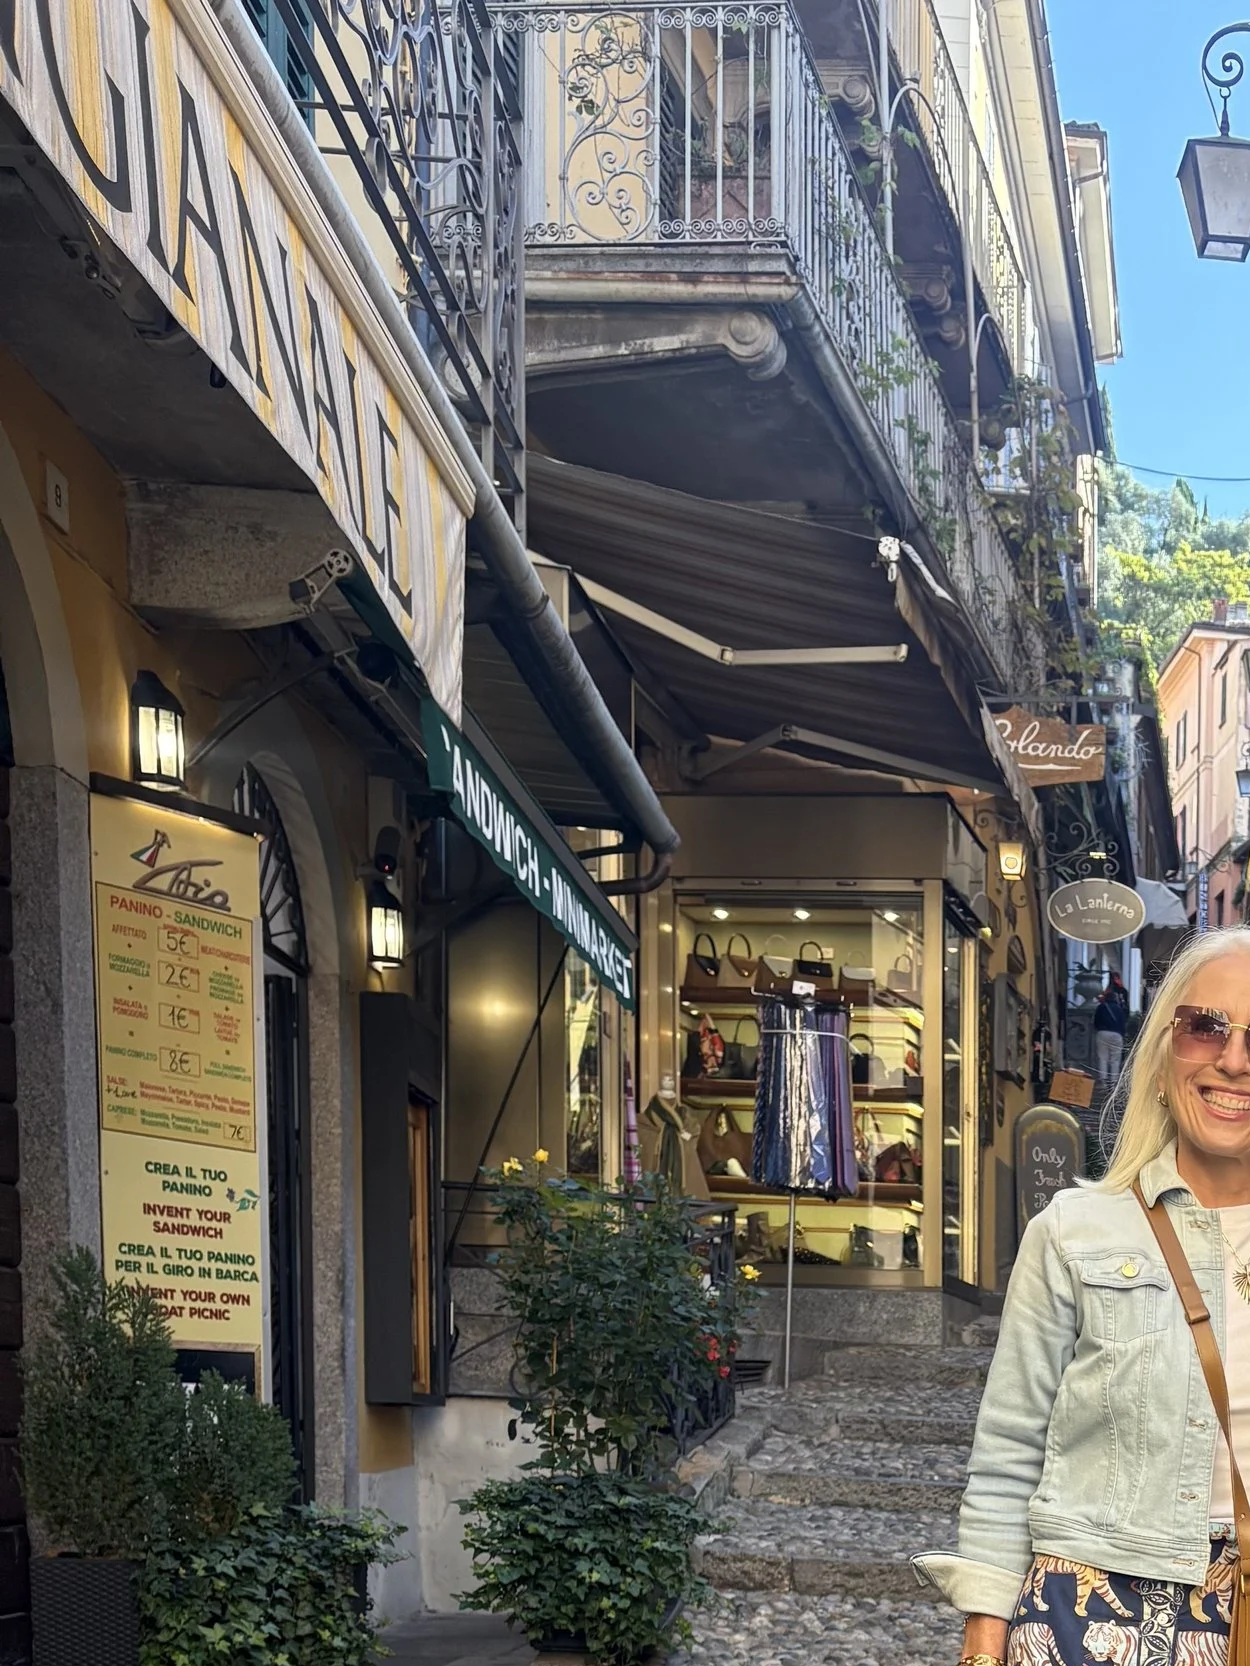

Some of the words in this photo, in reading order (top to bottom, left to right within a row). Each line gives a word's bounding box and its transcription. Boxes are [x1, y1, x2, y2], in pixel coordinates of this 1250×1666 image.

[440, 724, 541, 898] ANDWICH
[551, 866, 633, 1000] MINIMARKET
[109, 893, 162, 919] PANINO
[173, 910, 242, 939] SANDWICH
[1056, 904, 1074, 918] La
[1076, 893, 1136, 919] Lanterna
[165, 930, 190, 956] 5€
[164, 962, 191, 989] 2€
[167, 1004, 189, 1029] 1€
[168, 1049, 190, 1075] 8€
[228, 1124, 244, 1140] 7€
[1032, 1146, 1066, 1168] Only
[145, 1161, 180, 1177] CREA
[185, 1166, 197, 1179] IL
[201, 1167, 228, 1182] TUO
[162, 1180, 213, 1197] PANINO
[142, 1202, 193, 1219] INVENT
[197, 1208, 232, 1224] YOUR
[152, 1221, 223, 1239] SANDWICH
[118, 1242, 155, 1257] CREA
[160, 1246, 172, 1259] IL
[176, 1248, 204, 1261] TUO
[207, 1250, 256, 1266] PANINO
[115, 1258, 142, 1273] PER
[147, 1261, 159, 1274] IL
[163, 1262, 194, 1277] GIRO
[198, 1265, 212, 1279] IN
[215, 1266, 260, 1283] BARCA
[180, 1289, 217, 1304] YOUR
[220, 1292, 250, 1306] OWN
[189, 1306, 231, 1321] PICNIC
